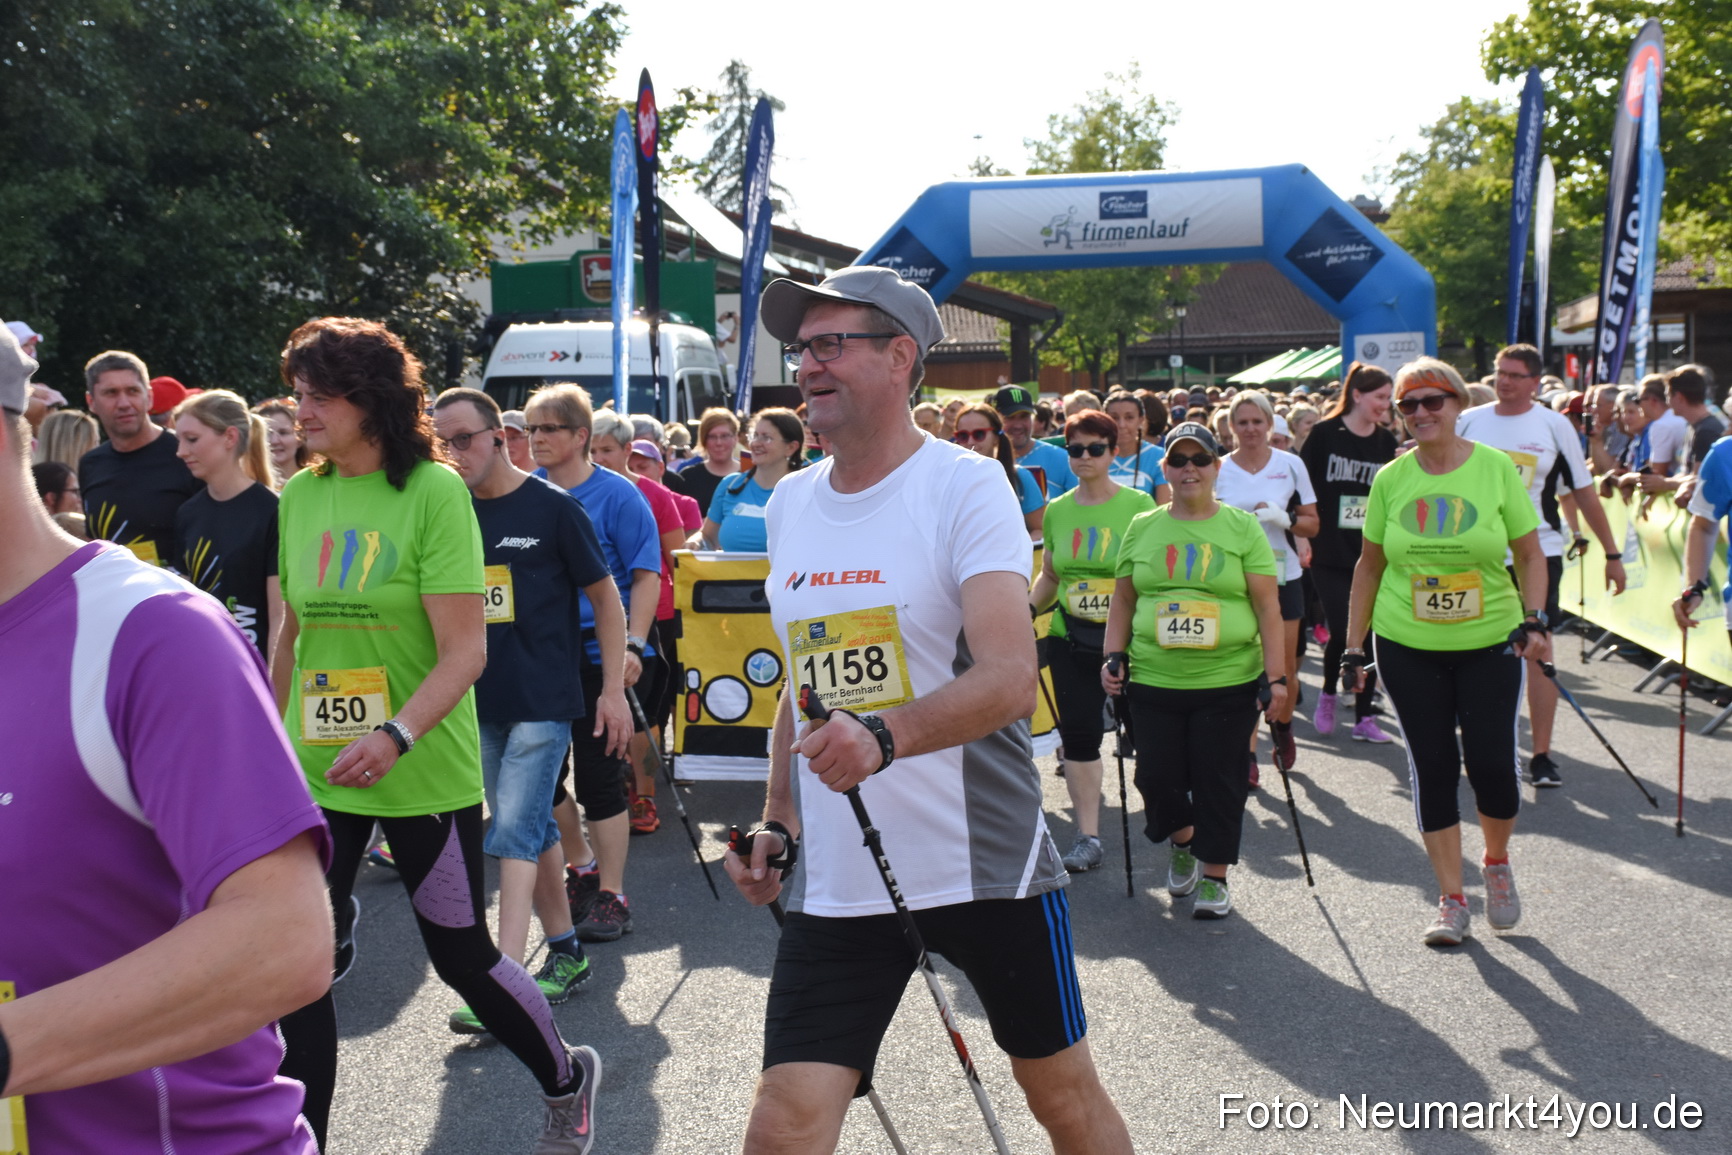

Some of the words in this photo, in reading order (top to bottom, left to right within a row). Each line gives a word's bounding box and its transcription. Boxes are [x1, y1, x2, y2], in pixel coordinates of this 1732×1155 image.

[1082, 217, 1190, 241] firmenlauf
[1082, 241, 1127, 249] neumarkt
[501, 351, 547, 362] abavent
[1176, 425, 1198, 437] CAT
[1326, 453, 1384, 486] COMPTO
[809, 570, 886, 587] KLEBL
[1078, 595, 1110, 611] 444
[1427, 591, 1467, 610] 457
[1167, 617, 1205, 635] 445
[802, 632, 842, 649] firmenlauf
[803, 645, 888, 691] 1158
[839, 683, 884, 697] Bernhard
[316, 696, 367, 724] 450
[829, 700, 844, 708] Klebl
[846, 697, 865, 706] GmbH
[333, 724, 371, 732] Alexandra
